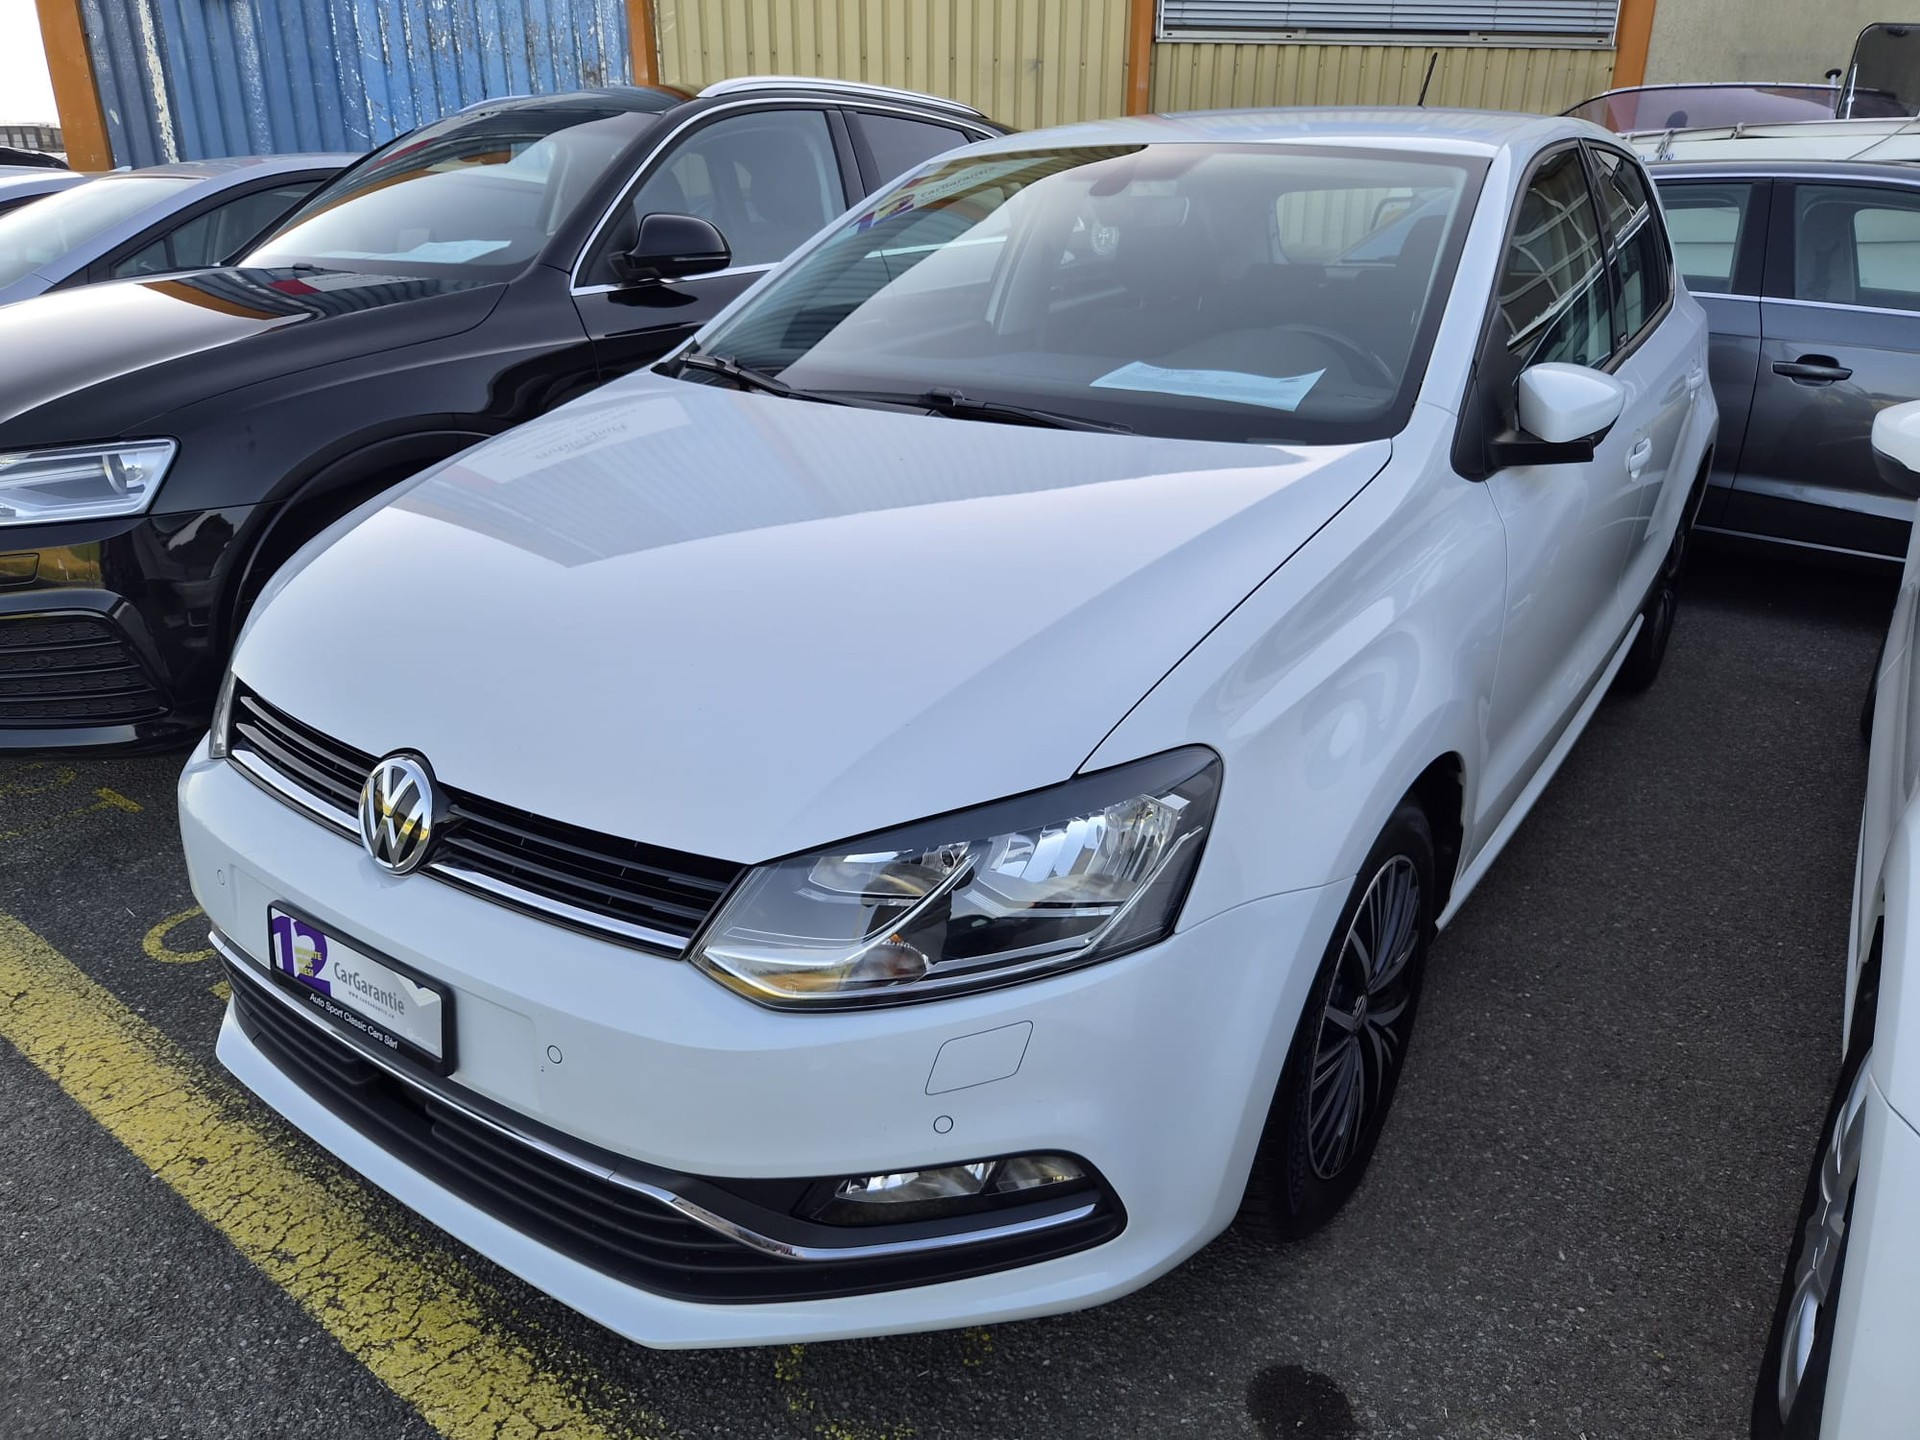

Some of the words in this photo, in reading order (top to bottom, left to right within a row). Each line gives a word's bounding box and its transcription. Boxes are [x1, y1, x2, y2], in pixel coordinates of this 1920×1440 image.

[271, 915, 332, 998] 12
[333, 961, 405, 1016] CarGarantie
[309, 992, 325, 1008] Auto
[325, 1001, 344, 1019] Sport
[344, 1012, 367, 1032] Classic
[367, 1025, 384, 1042] Cars
